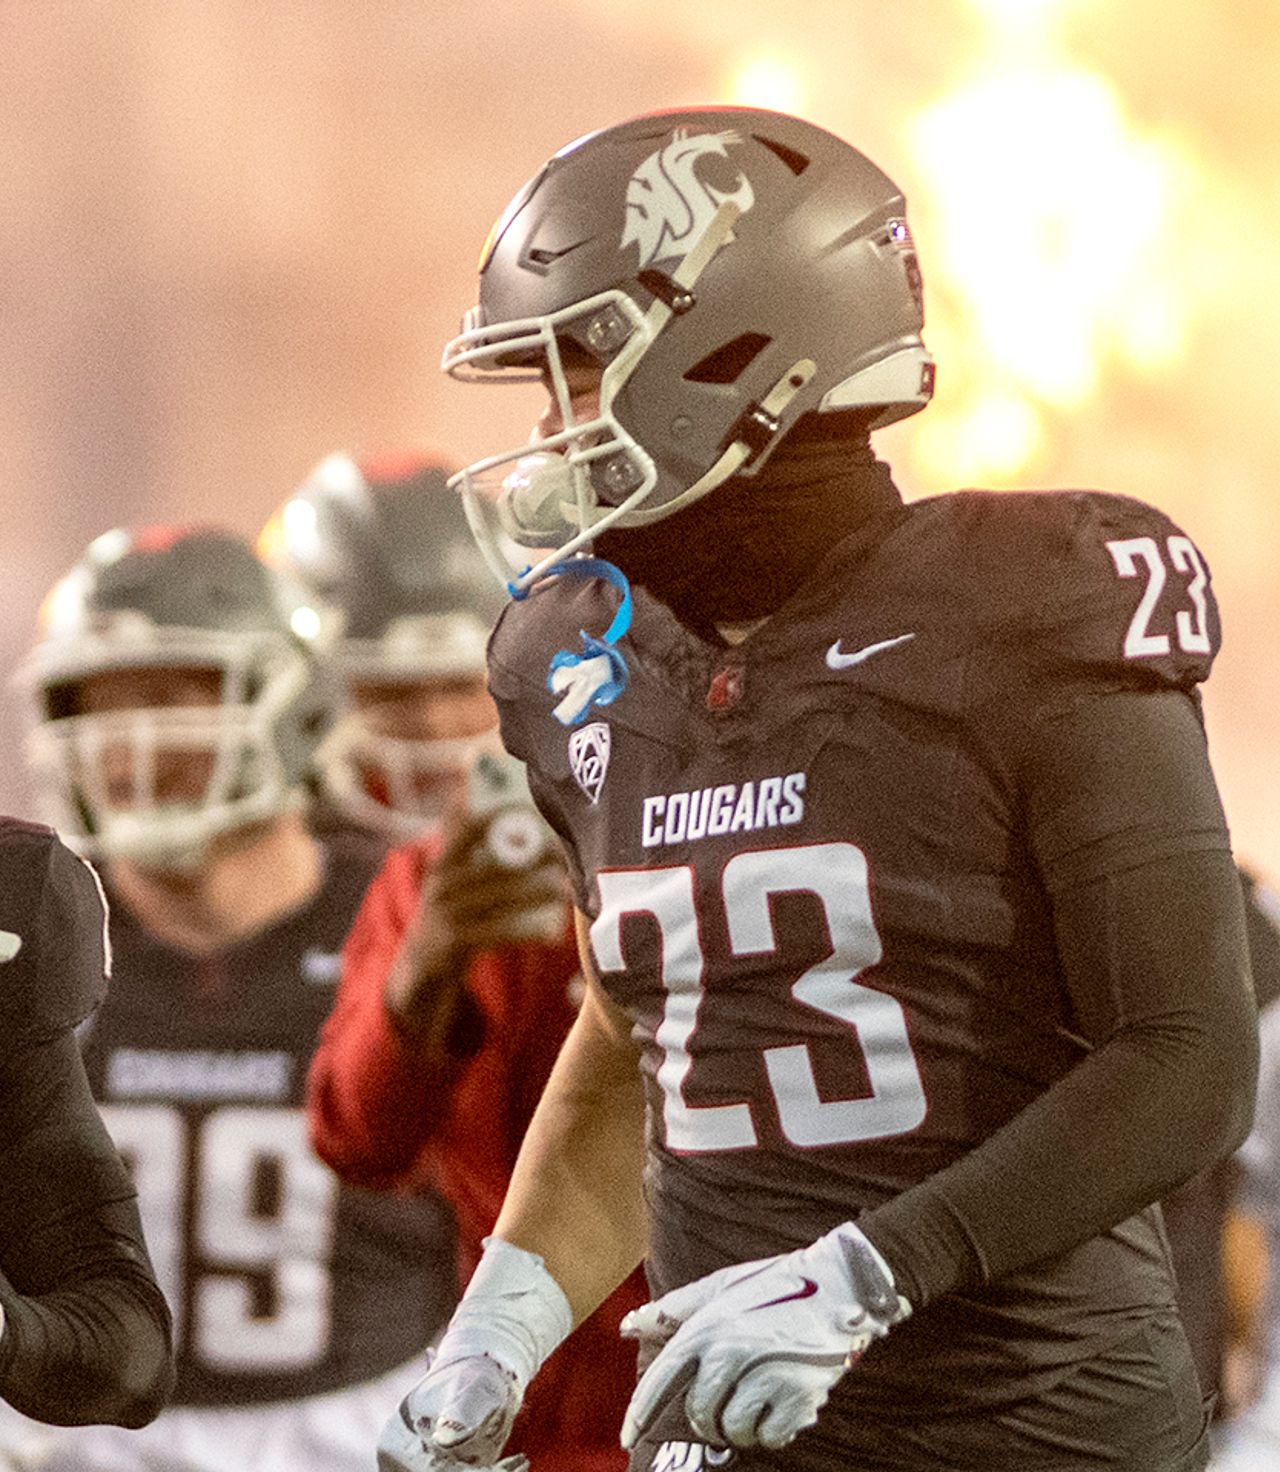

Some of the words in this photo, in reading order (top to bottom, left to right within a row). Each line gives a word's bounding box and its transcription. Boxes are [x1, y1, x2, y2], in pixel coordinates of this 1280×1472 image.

[1104, 535, 1212, 658] 23
[641, 772, 806, 848] COUGARS
[590, 842, 927, 1155] 23
